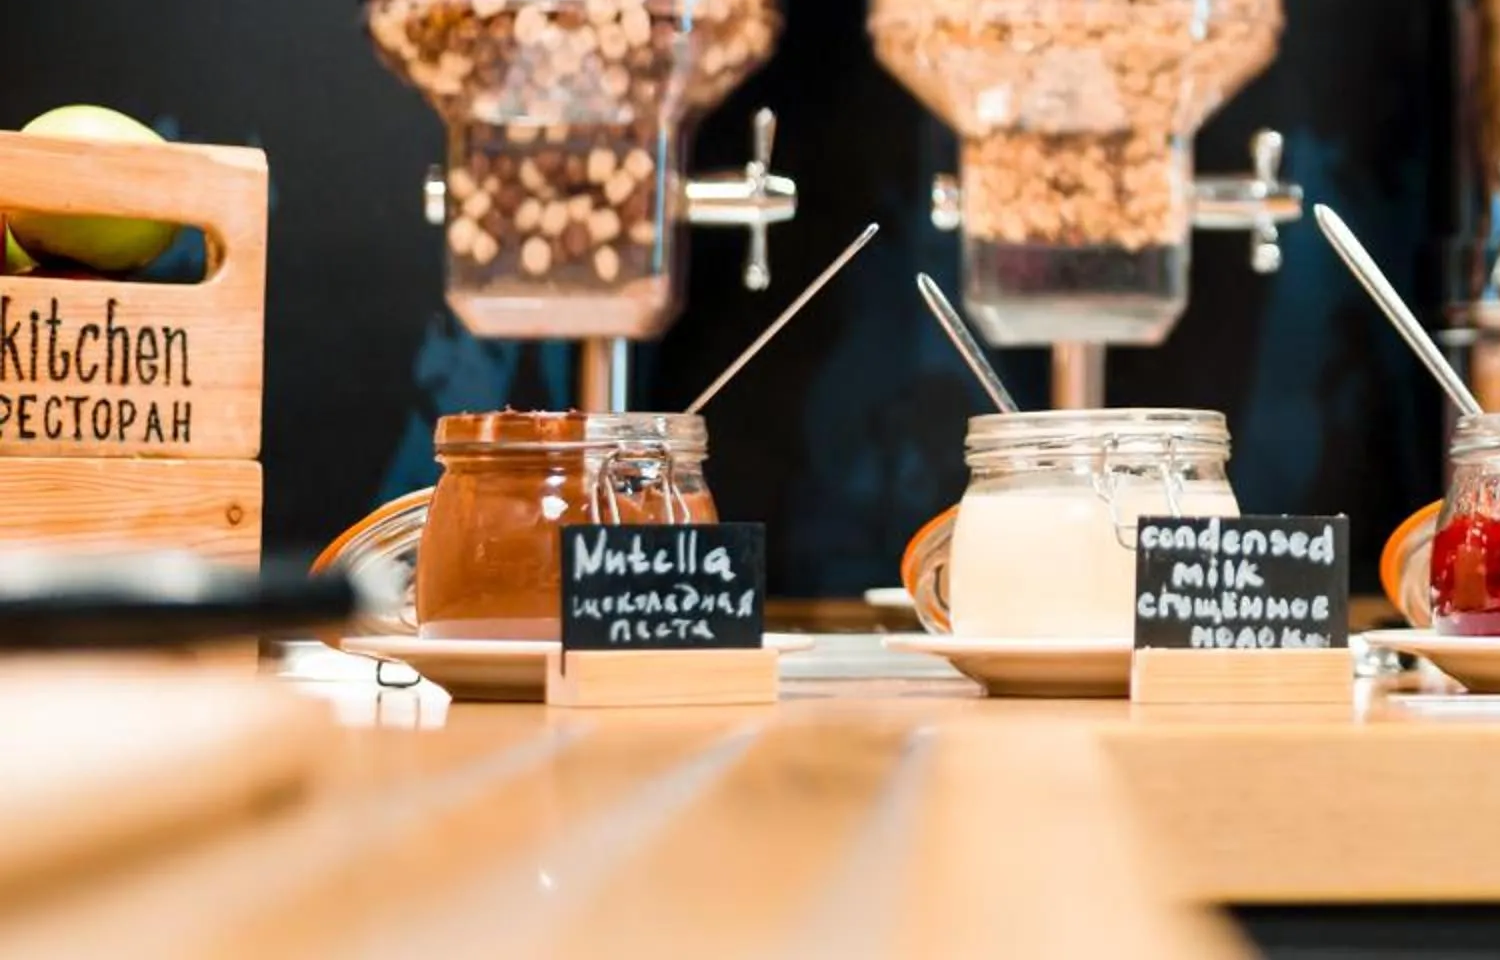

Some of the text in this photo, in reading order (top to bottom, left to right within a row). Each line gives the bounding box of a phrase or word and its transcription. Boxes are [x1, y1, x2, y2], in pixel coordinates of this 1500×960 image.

[0, 296, 192, 386] kitchen
[573, 527, 737, 582] Nutella
[1140, 516, 1335, 566] condensed
[572, 582, 755, 619] шоколадная
[609, 617, 716, 642] паста
